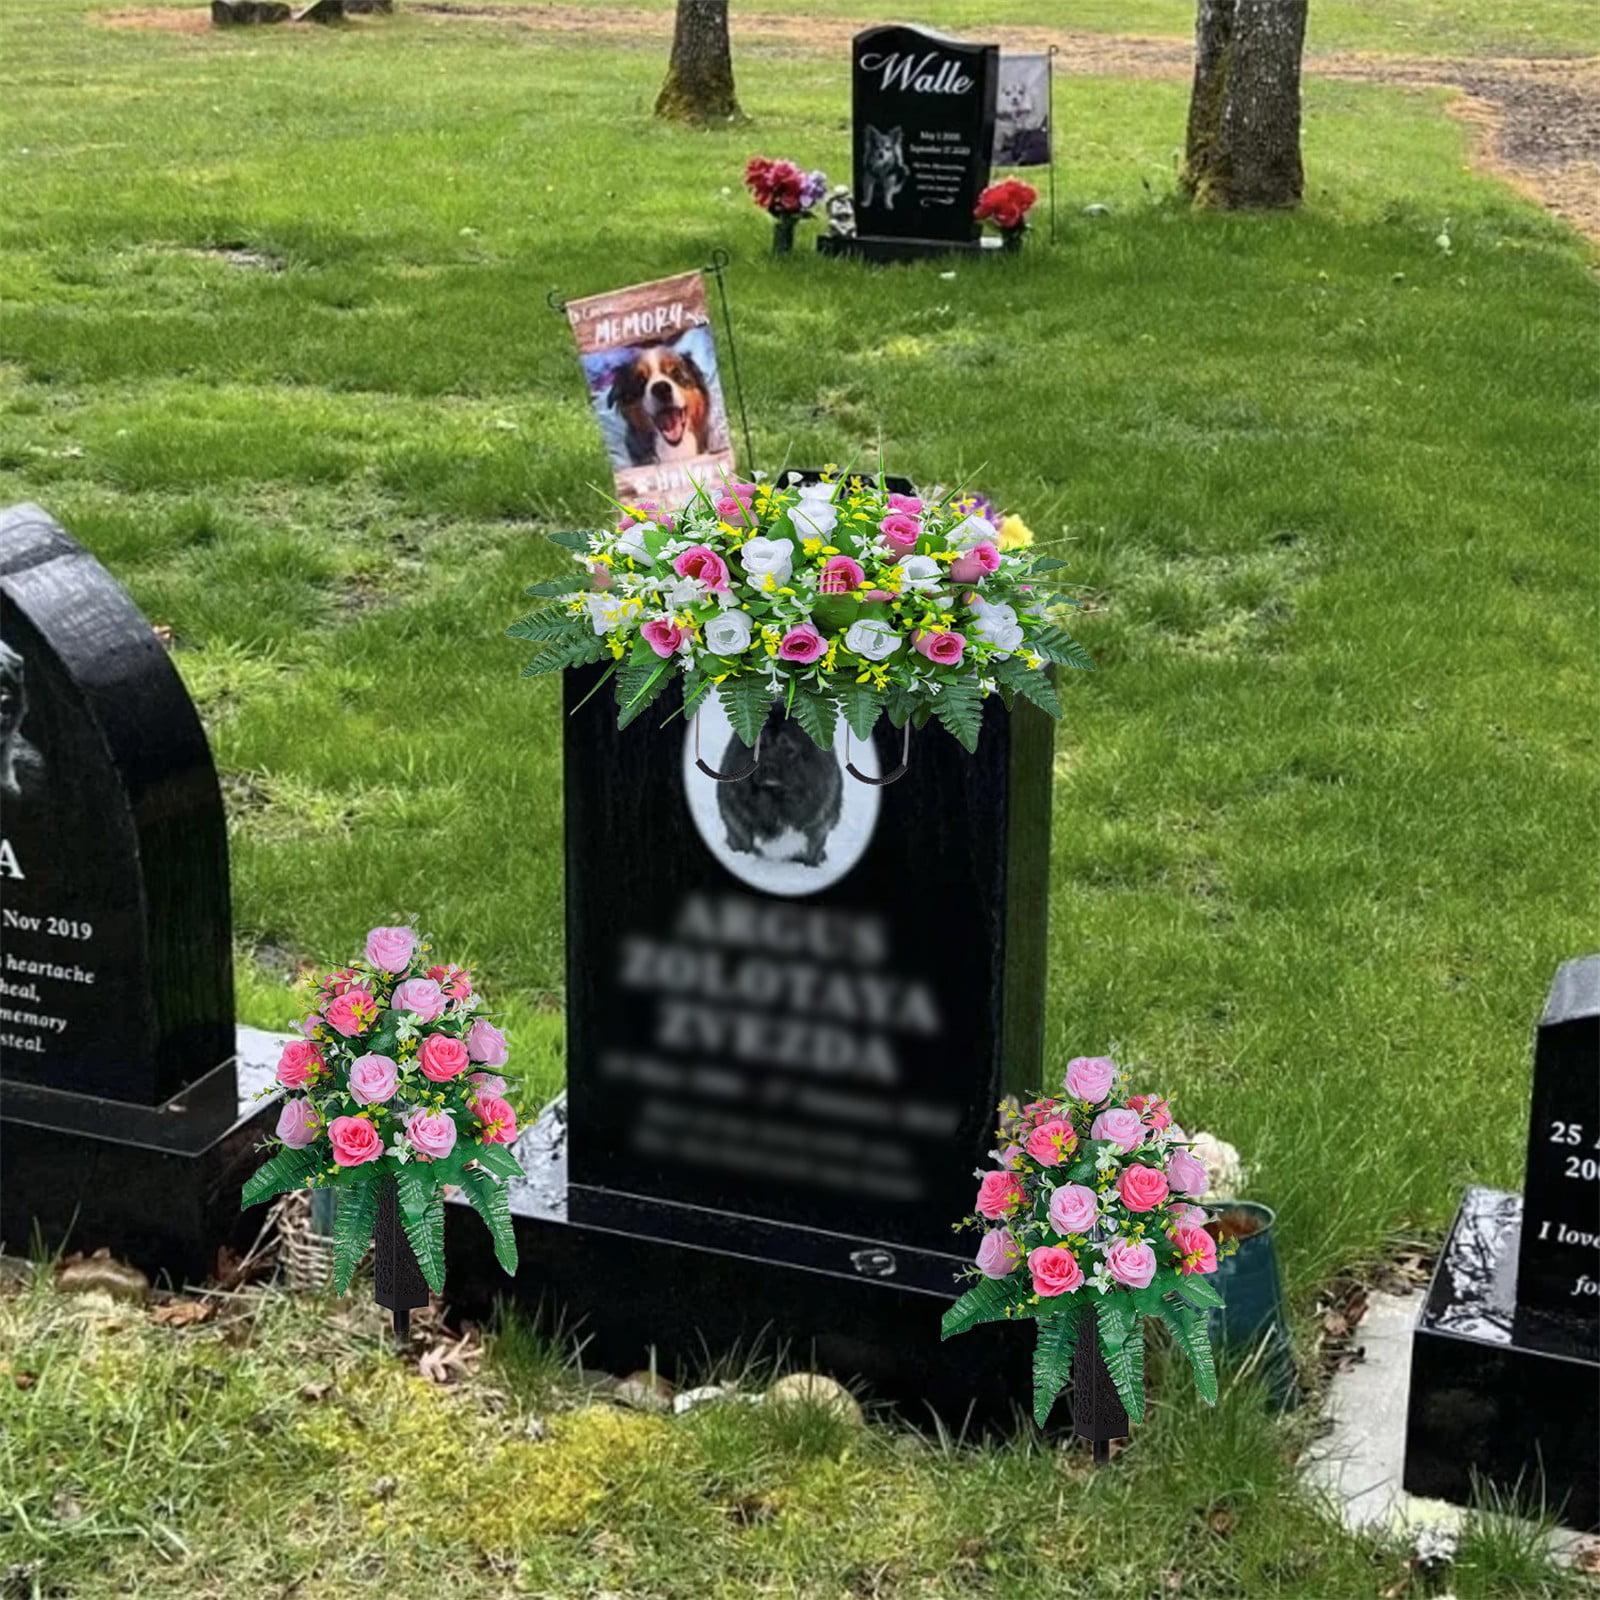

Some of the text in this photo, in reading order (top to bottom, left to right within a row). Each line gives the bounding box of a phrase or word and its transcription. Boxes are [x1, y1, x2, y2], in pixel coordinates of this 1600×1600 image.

[860, 51, 975, 95] Walle
[595, 302, 684, 346] MEMORY
[3, 908, 93, 940] Nov 2019
[676, 893, 888, 964] ARGUS
[6, 953, 95, 984] heartache
[619, 936, 940, 1034] ZOLOTAYA
[0, 1008, 67, 1034] memory
[657, 1000, 899, 1082] ZVEZDA
[1550, 1121, 1583, 1145] 25
[1564, 1156, 1600, 1180] 20
[1538, 1221, 1551, 1240] I
[1570, 1274, 1600, 1296] fo
